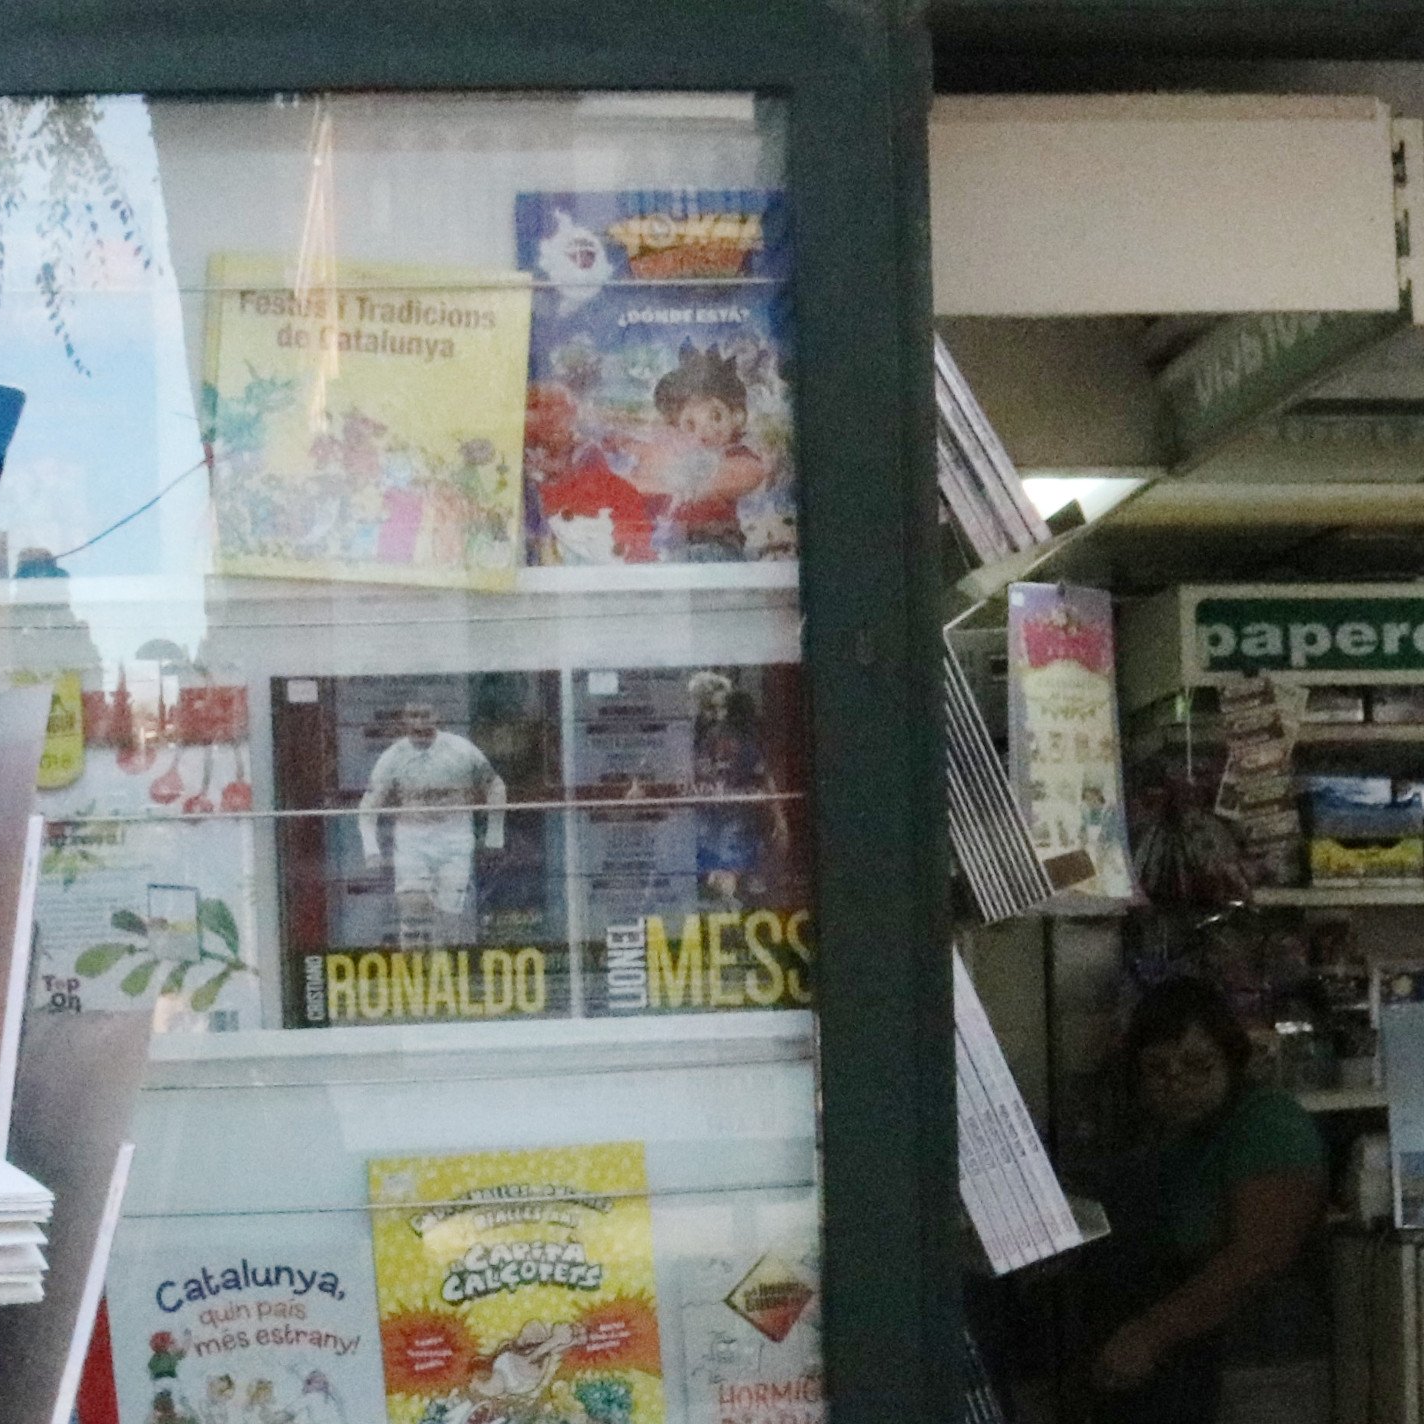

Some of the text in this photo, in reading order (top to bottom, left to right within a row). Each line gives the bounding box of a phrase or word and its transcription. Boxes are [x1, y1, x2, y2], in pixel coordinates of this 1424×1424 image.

[326, 947, 546, 1018] RONALDO
[608, 916, 648, 1009] LIONEL
[155, 1257, 346, 1314] Catalunya,
